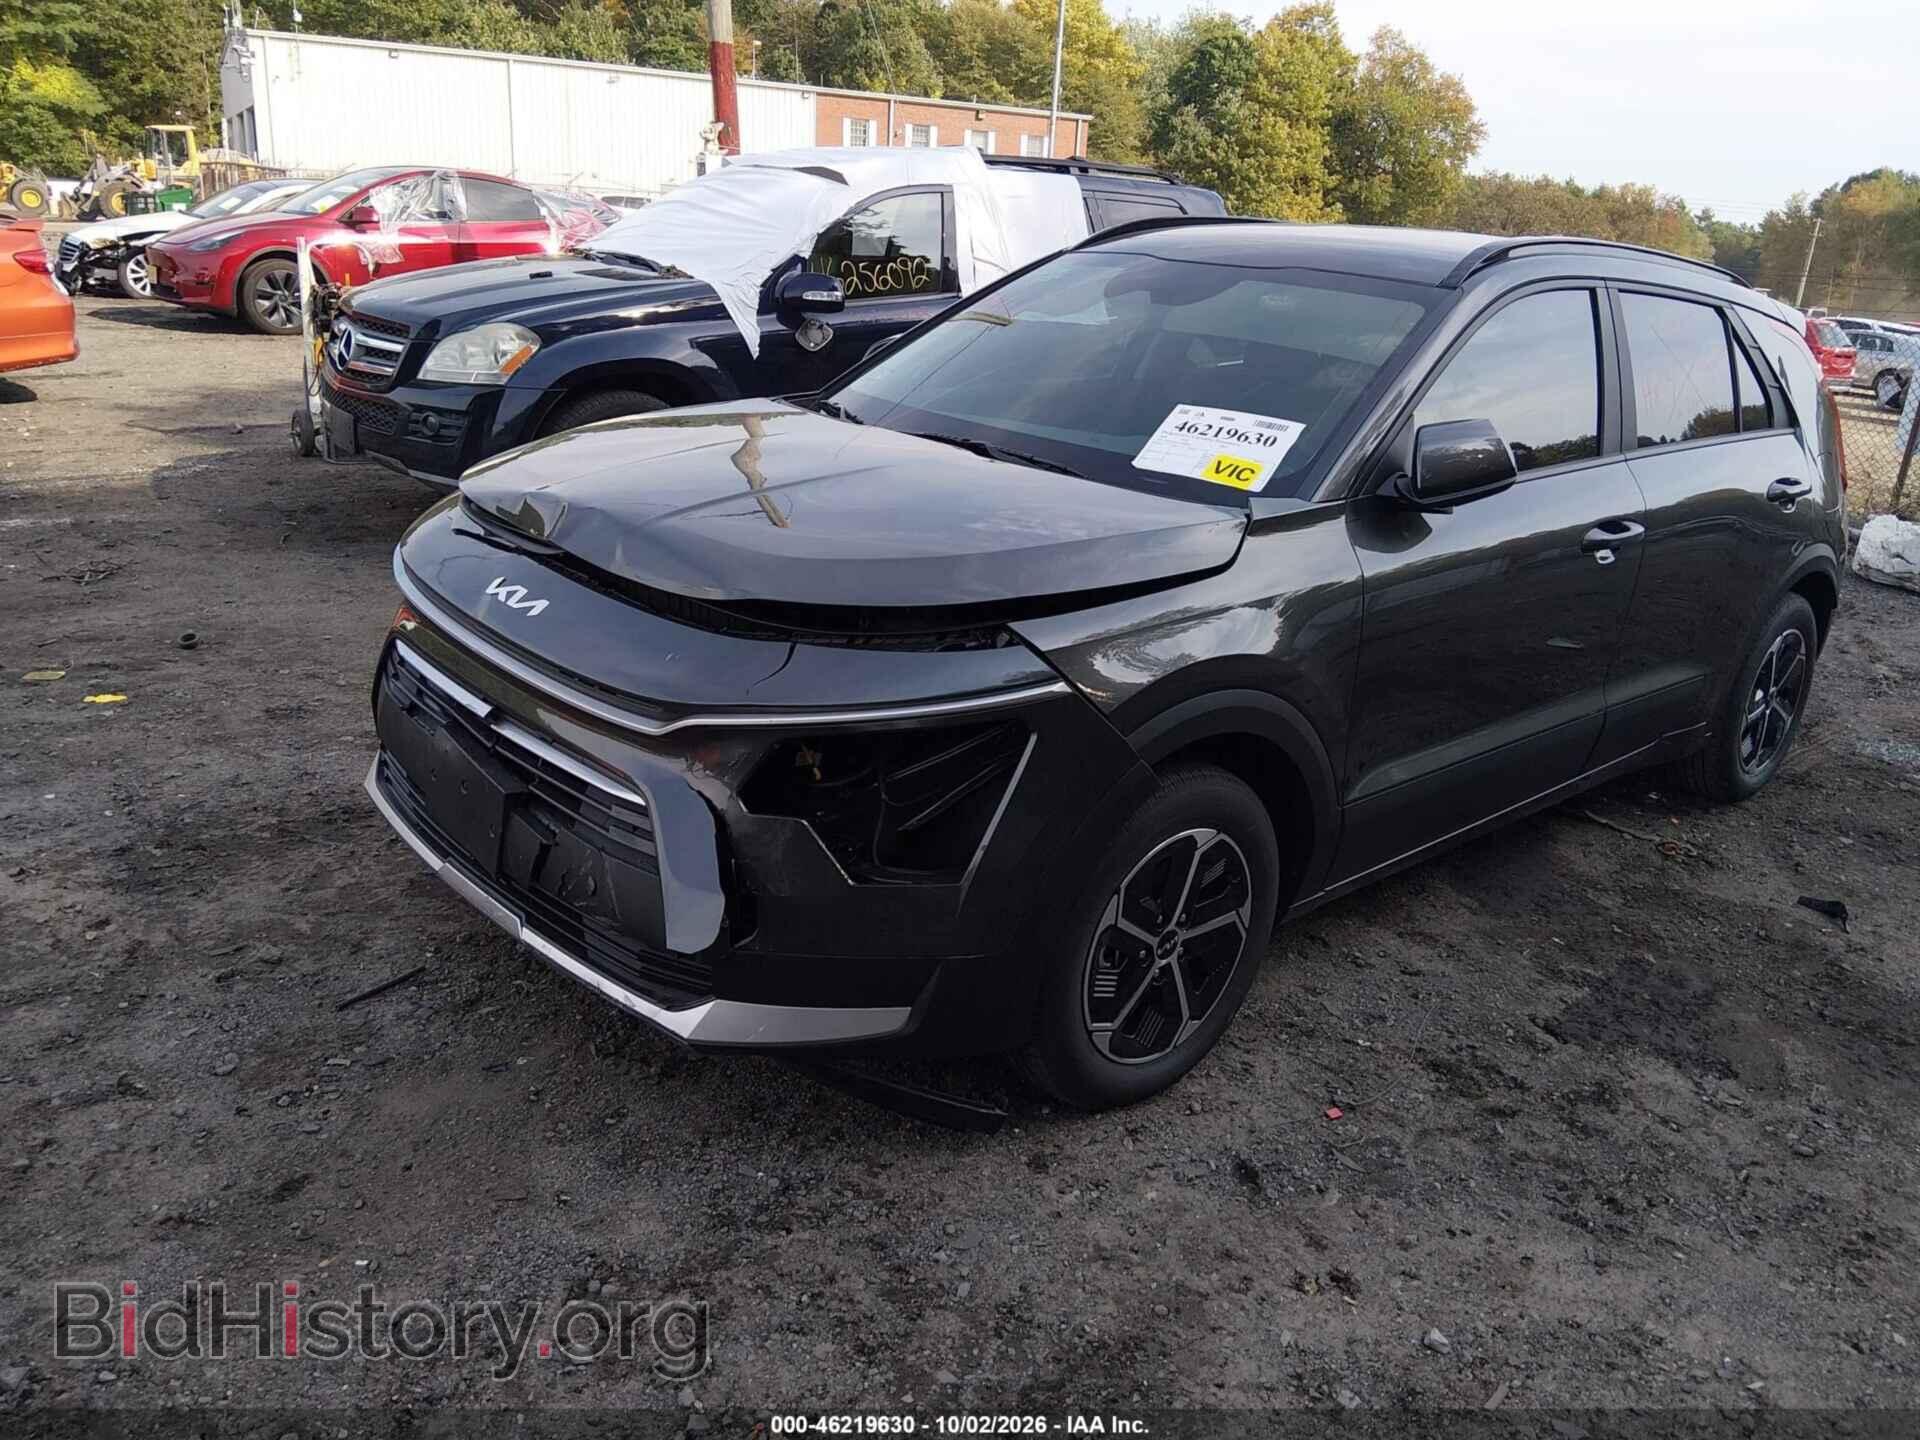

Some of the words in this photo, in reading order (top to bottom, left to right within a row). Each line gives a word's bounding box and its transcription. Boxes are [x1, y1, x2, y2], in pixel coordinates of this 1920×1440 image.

[1174, 421, 1278, 448] 46219630
[1214, 460, 1256, 482] VIC
[485, 576, 550, 617] KIA
